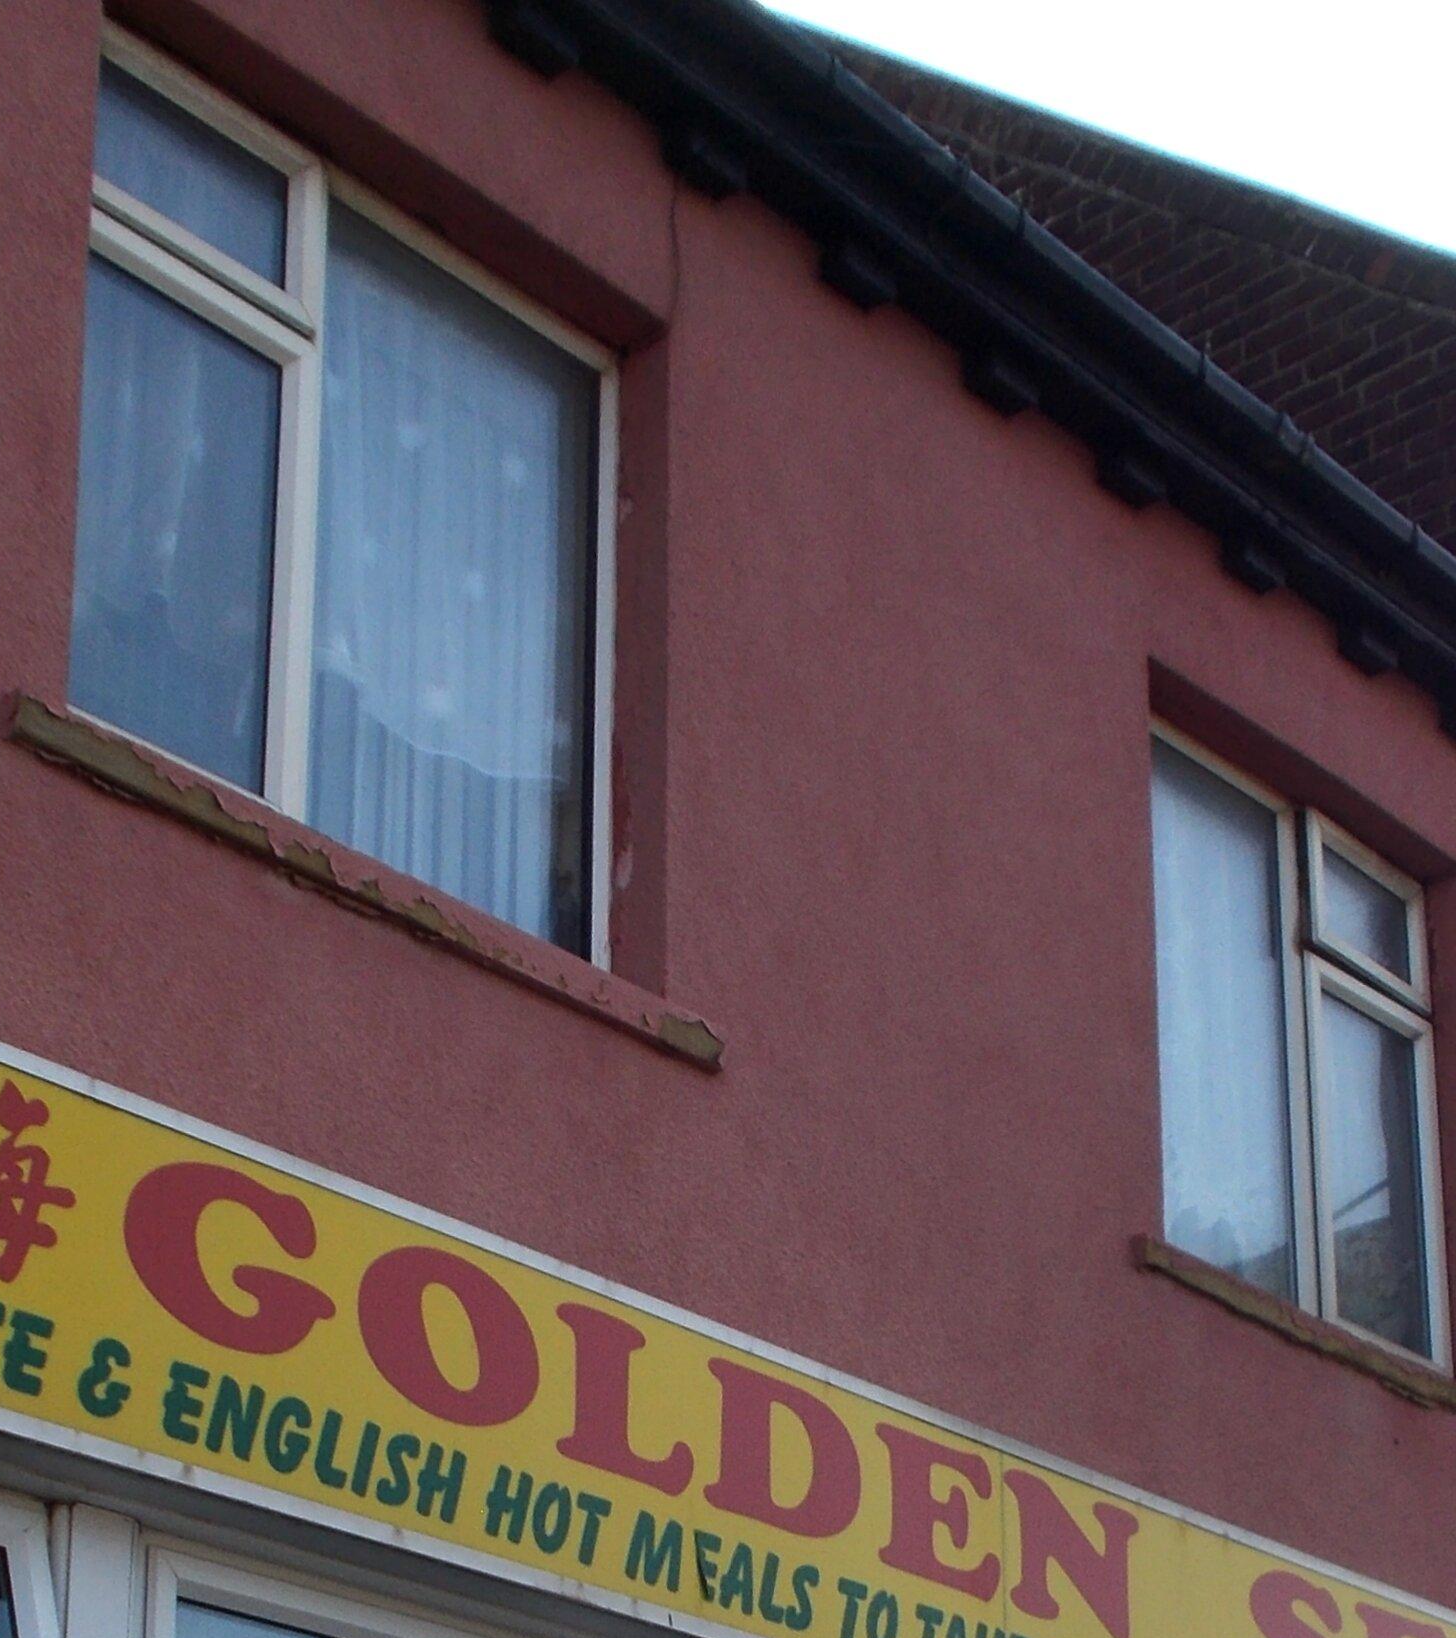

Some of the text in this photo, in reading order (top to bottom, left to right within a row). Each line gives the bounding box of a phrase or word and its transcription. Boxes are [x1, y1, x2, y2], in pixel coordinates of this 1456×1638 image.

[76, 1337, 132, 1420] &
[163, 1361, 466, 1524] ENGLISH
[485, 1464, 613, 1567] HOT
[624, 1511, 820, 1631] MEALS
